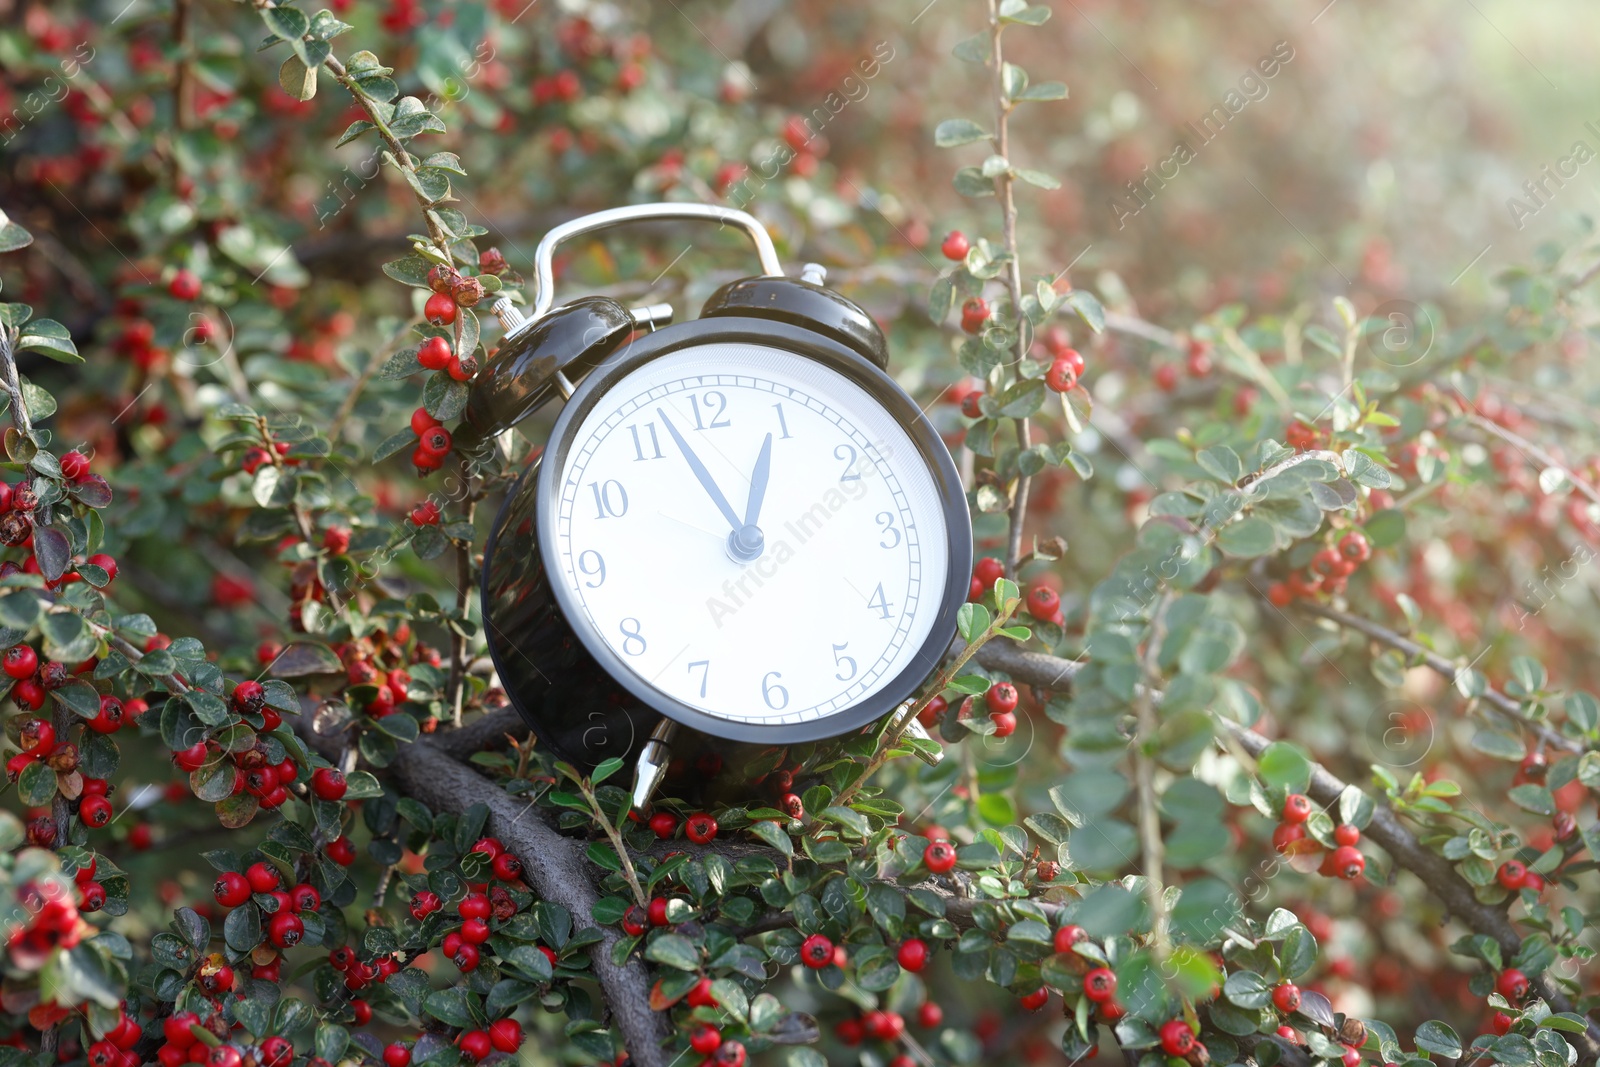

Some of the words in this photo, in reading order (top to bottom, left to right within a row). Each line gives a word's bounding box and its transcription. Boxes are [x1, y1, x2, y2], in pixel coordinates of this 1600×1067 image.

[686, 391, 731, 431] 12
[772, 402, 794, 440] 1
[626, 422, 667, 462] 11
[834, 444, 861, 482] 2
[587, 479, 628, 520] 10
[875, 511, 901, 549] 3
[578, 549, 606, 588] 9
[867, 581, 895, 619] 4
[619, 617, 647, 656] 8
[688, 660, 710, 698] 7
[832, 641, 857, 682] 5
[761, 671, 789, 710] 6
